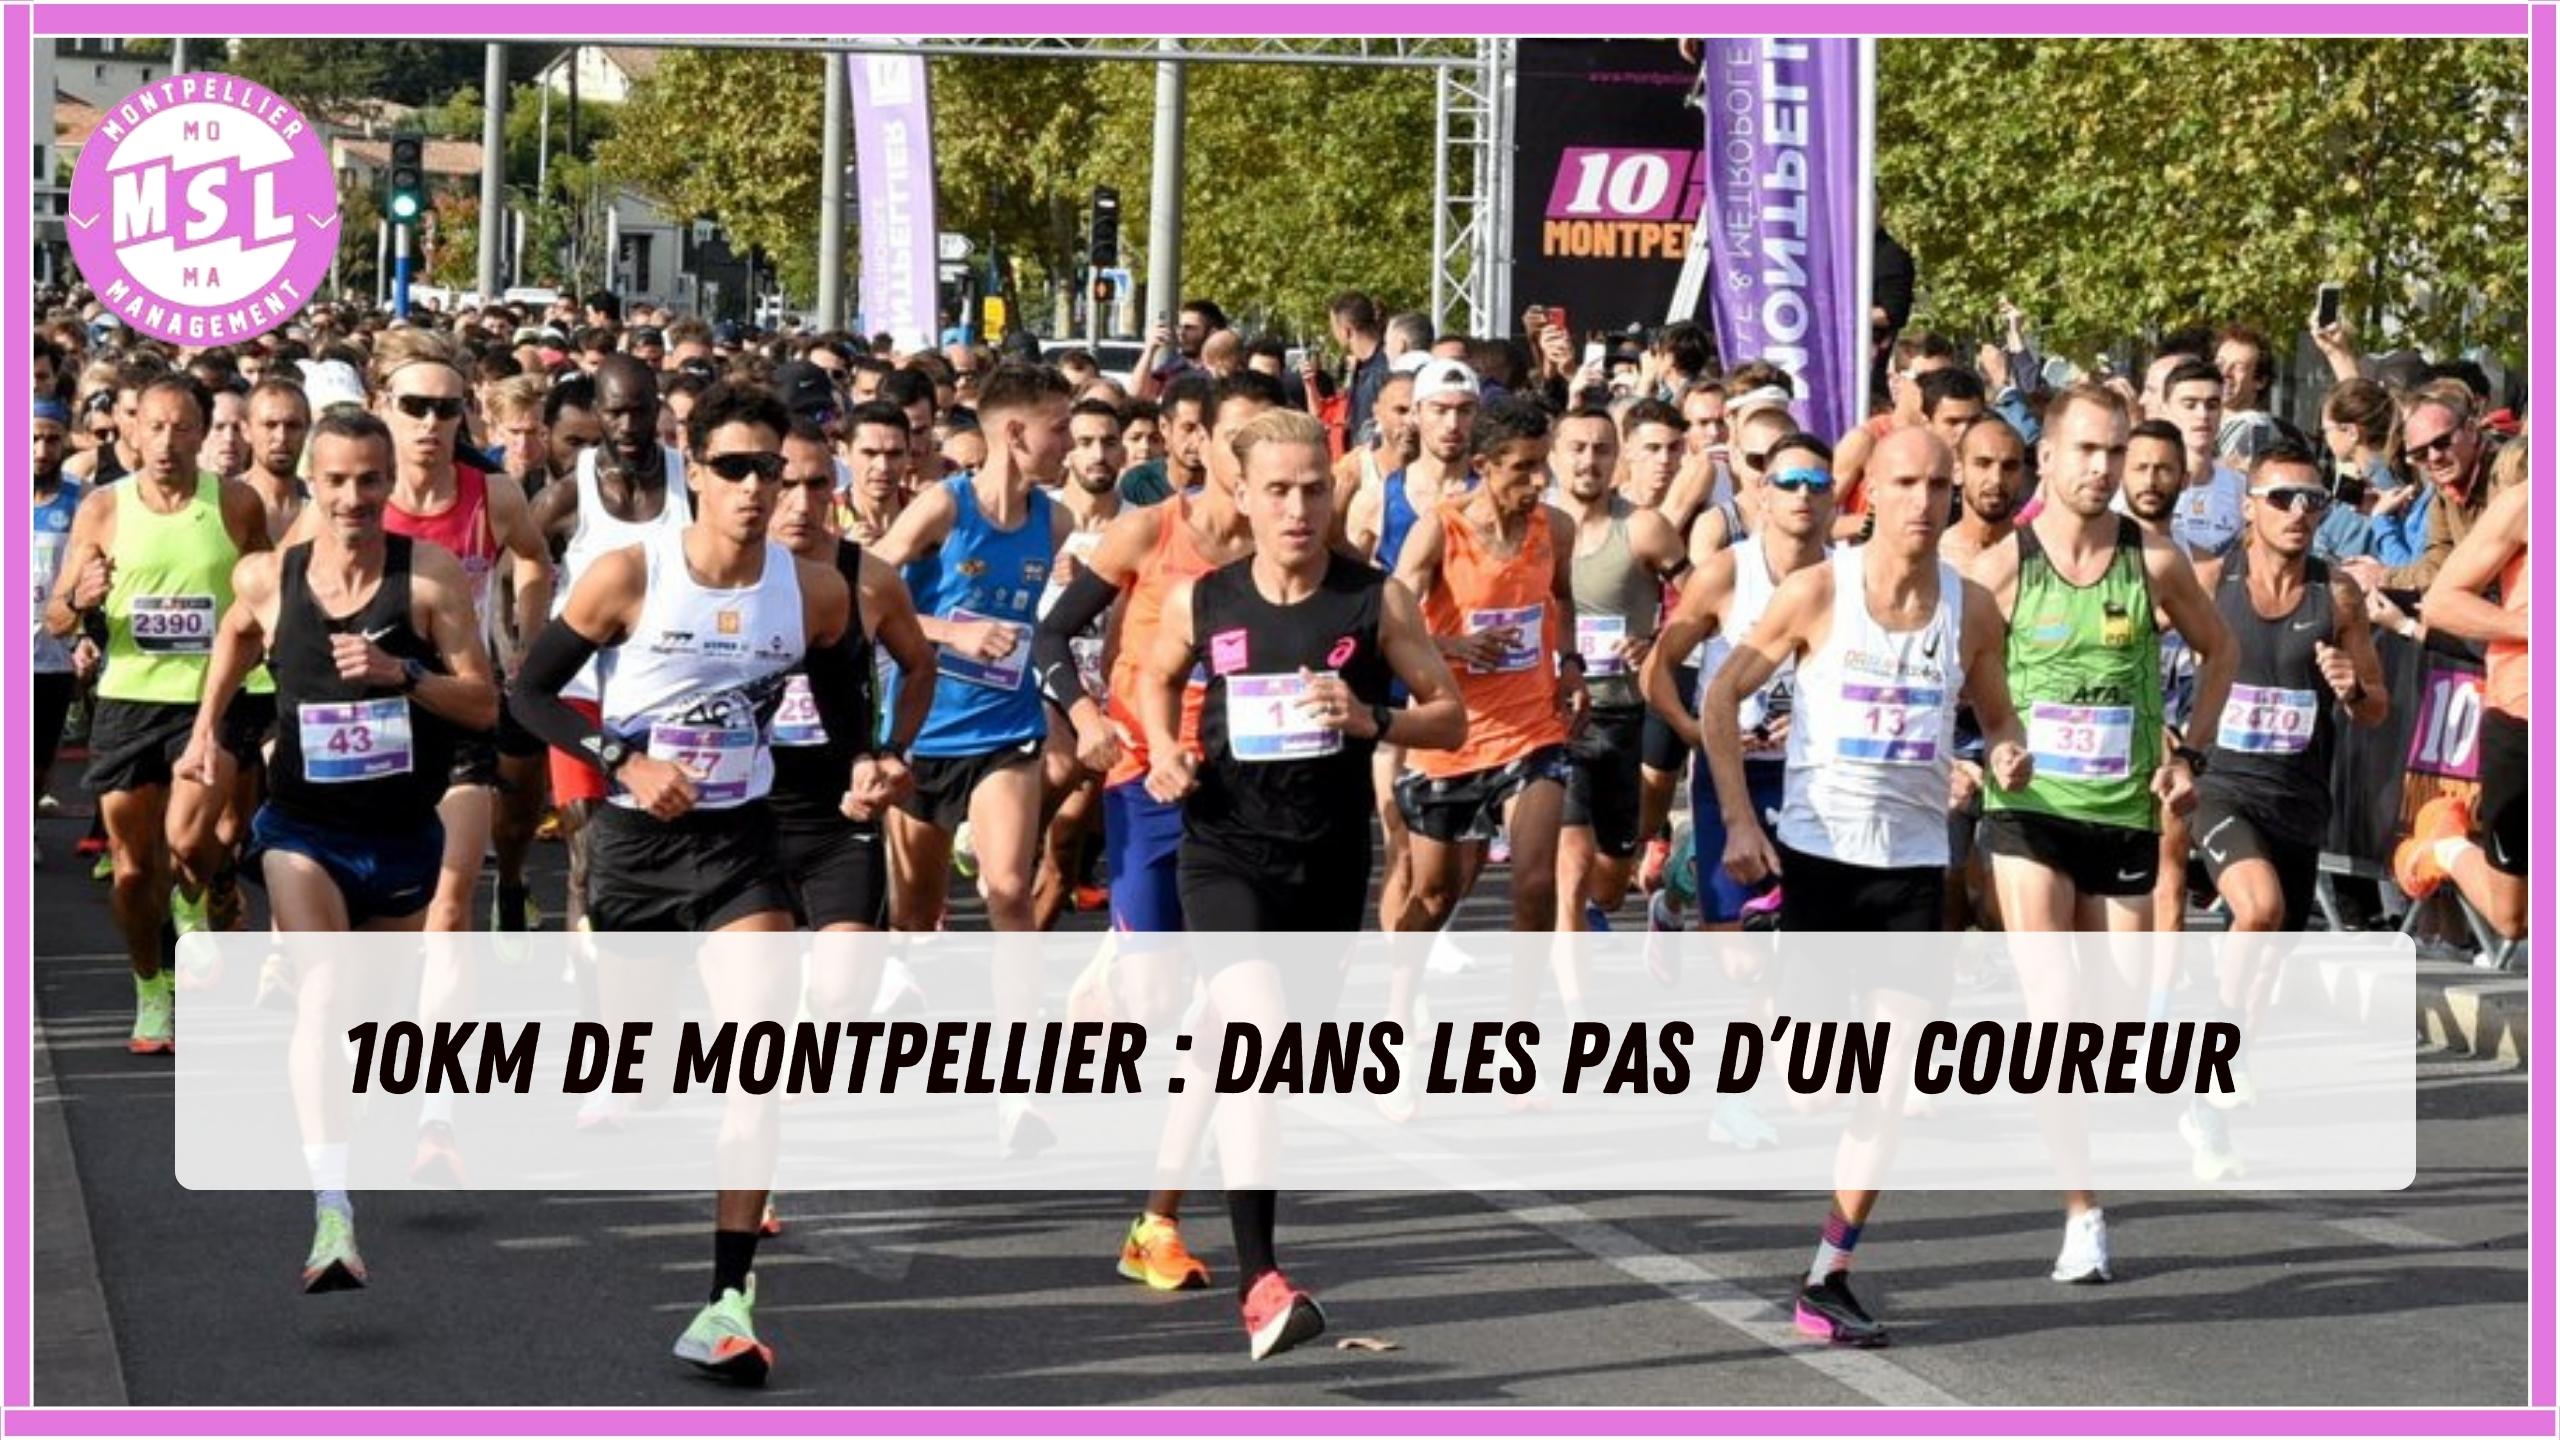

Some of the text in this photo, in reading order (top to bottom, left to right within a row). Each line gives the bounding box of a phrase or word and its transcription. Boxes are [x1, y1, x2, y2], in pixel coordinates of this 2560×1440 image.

[1566, 153, 1669, 214] 10
[135, 613, 202, 634] 2390
[1865, 706, 1906, 736] 13
[2419, 678, 2481, 767] 10
[328, 726, 373, 754] 43
[2057, 726, 2095, 752] 33
